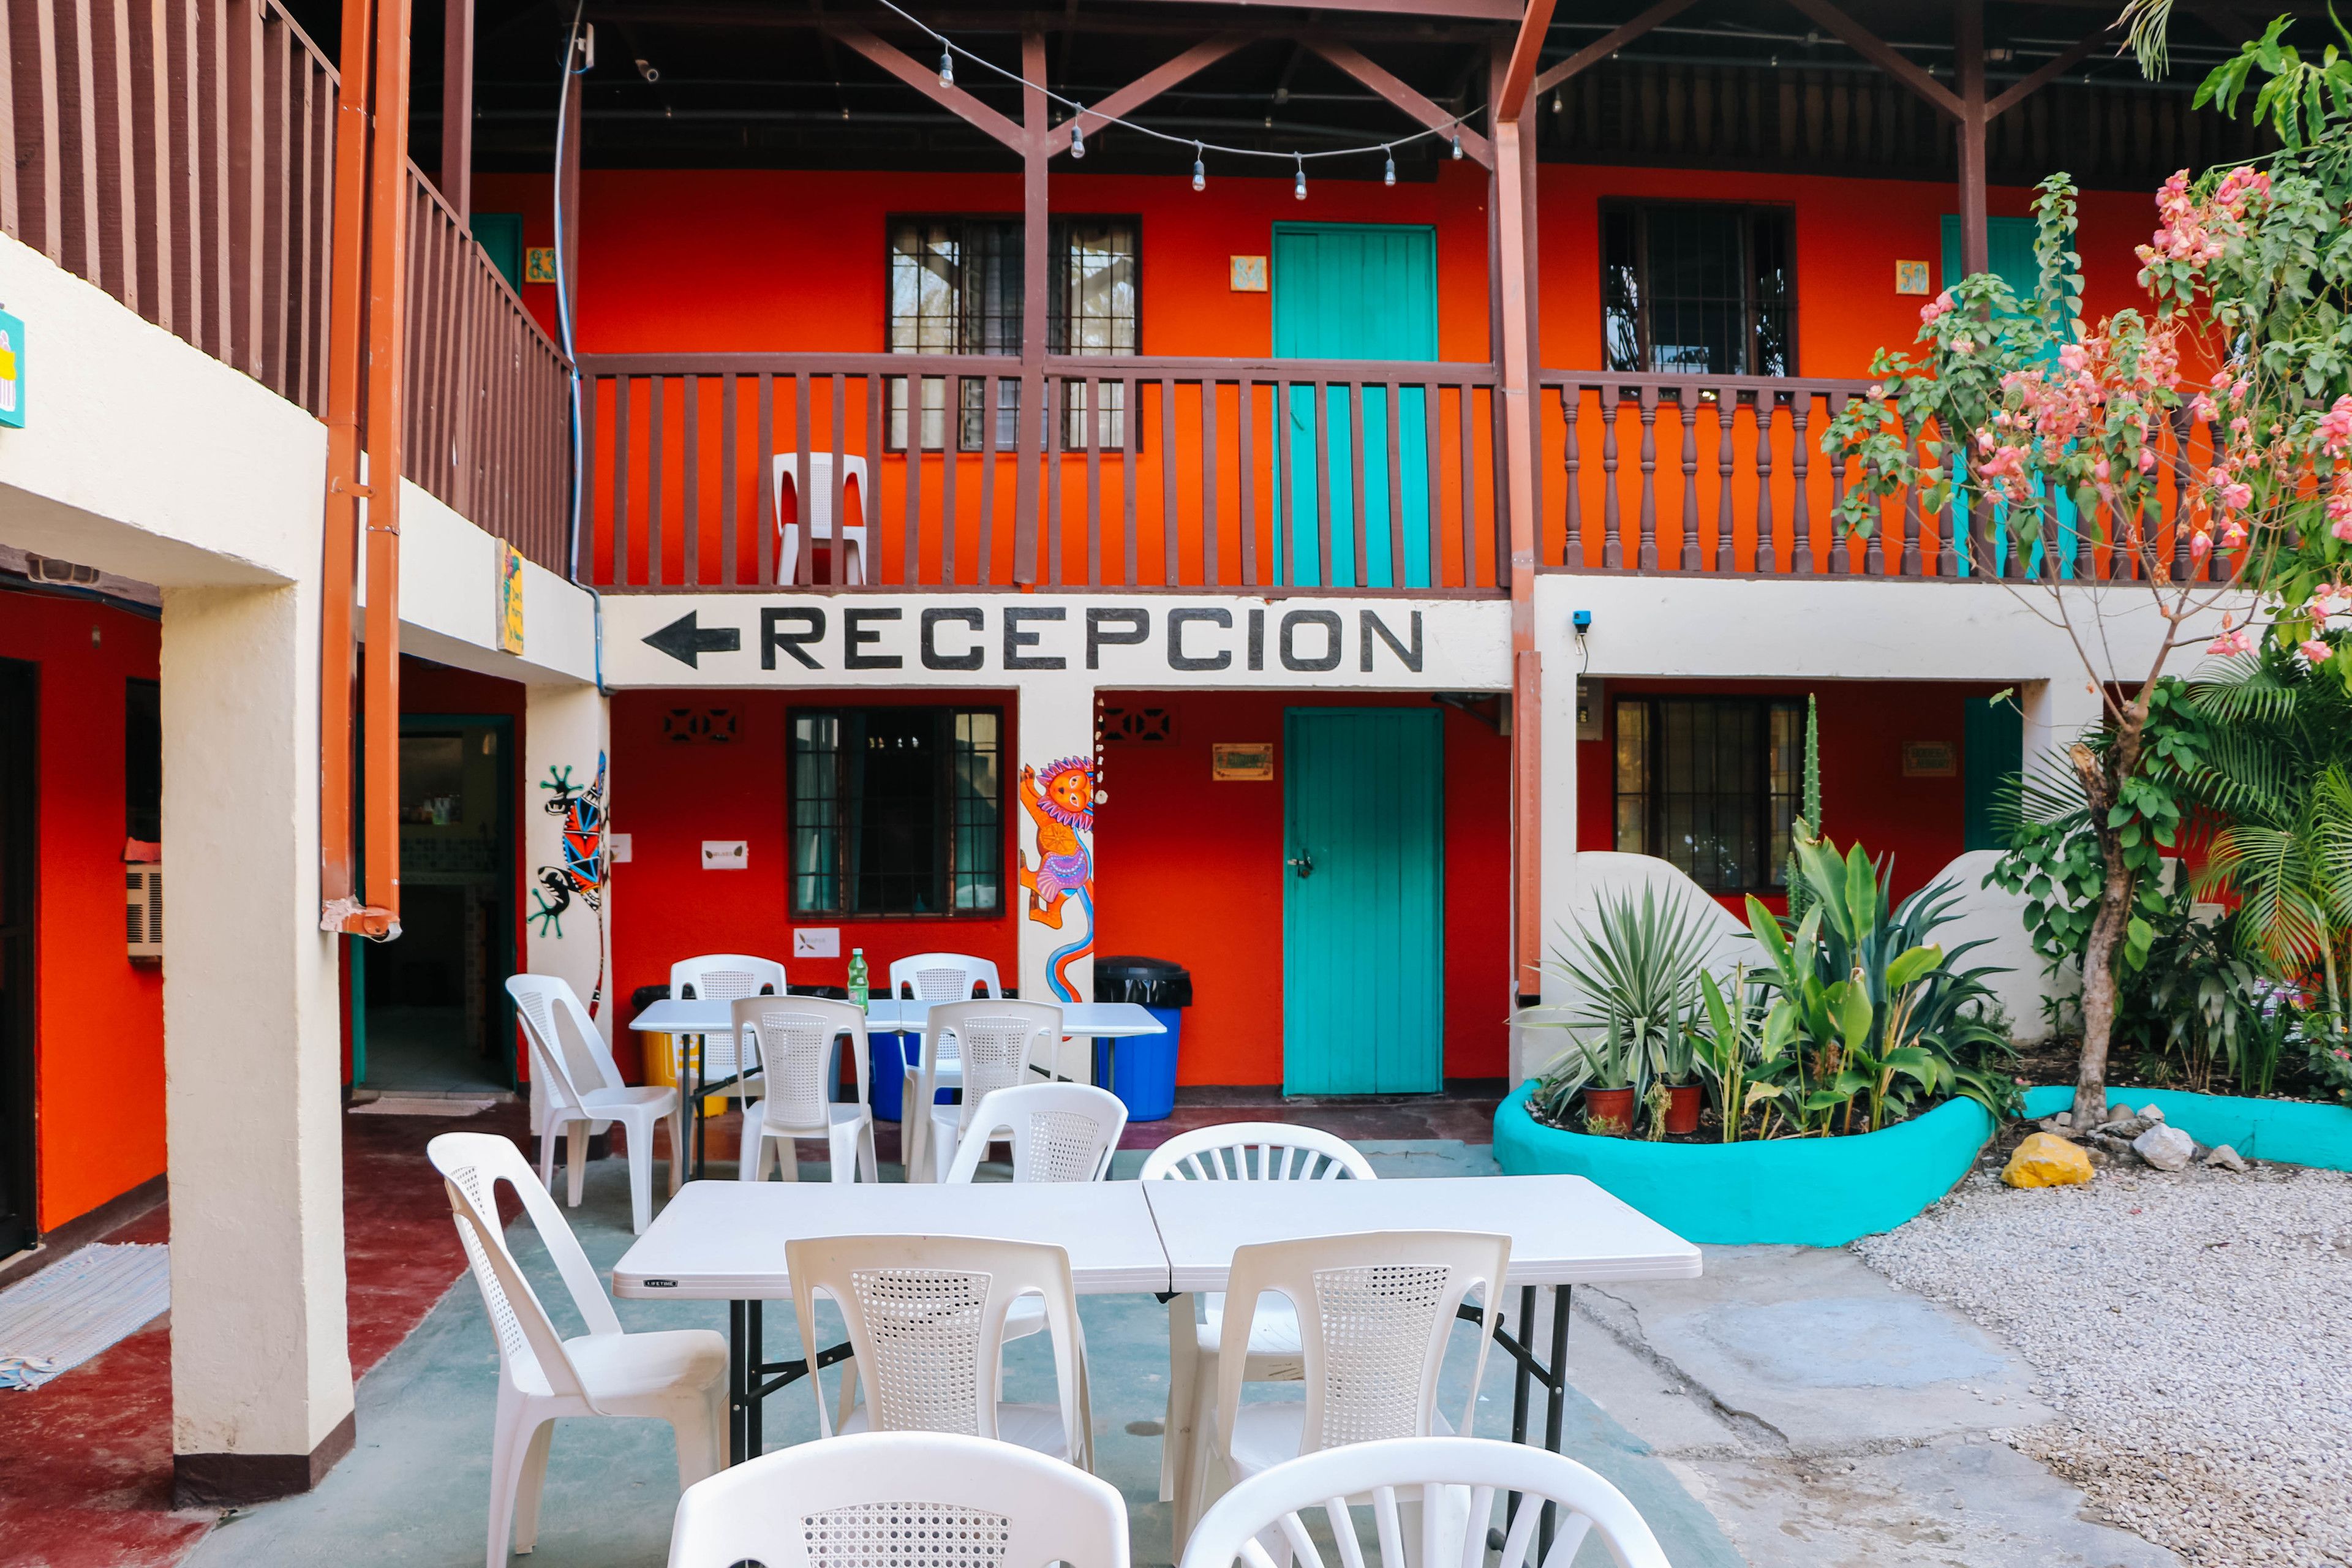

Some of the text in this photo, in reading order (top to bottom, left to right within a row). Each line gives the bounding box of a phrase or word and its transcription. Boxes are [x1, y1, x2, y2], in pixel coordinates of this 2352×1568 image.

[529, 249, 556, 279] 83
[1234, 258, 1264, 288] 84
[1901, 263, 1927, 292] 50
[761, 606, 1423, 673] RECEPCION
